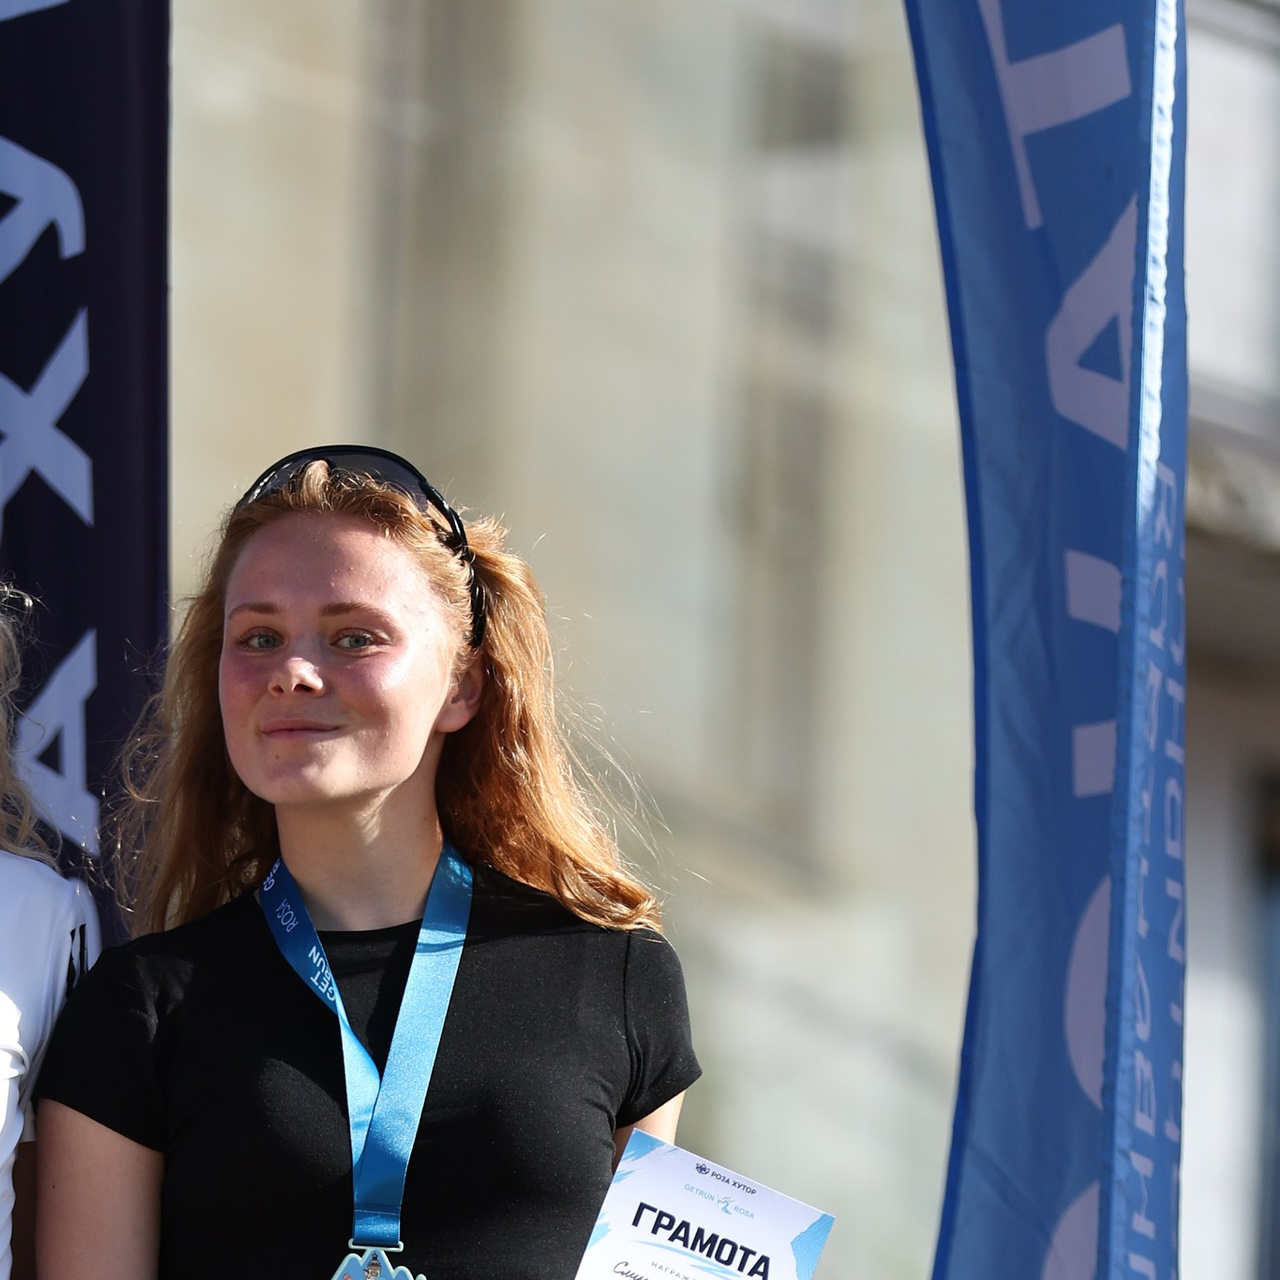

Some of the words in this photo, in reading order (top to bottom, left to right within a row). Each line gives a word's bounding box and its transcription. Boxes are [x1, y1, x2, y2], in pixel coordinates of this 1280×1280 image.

[711, 1171, 731, 1185] РОЗА
[731, 1180, 757, 1196] ХУТОР
[684, 1183, 715, 1202] GETRUN
[733, 1205, 755, 1219] ROSA
